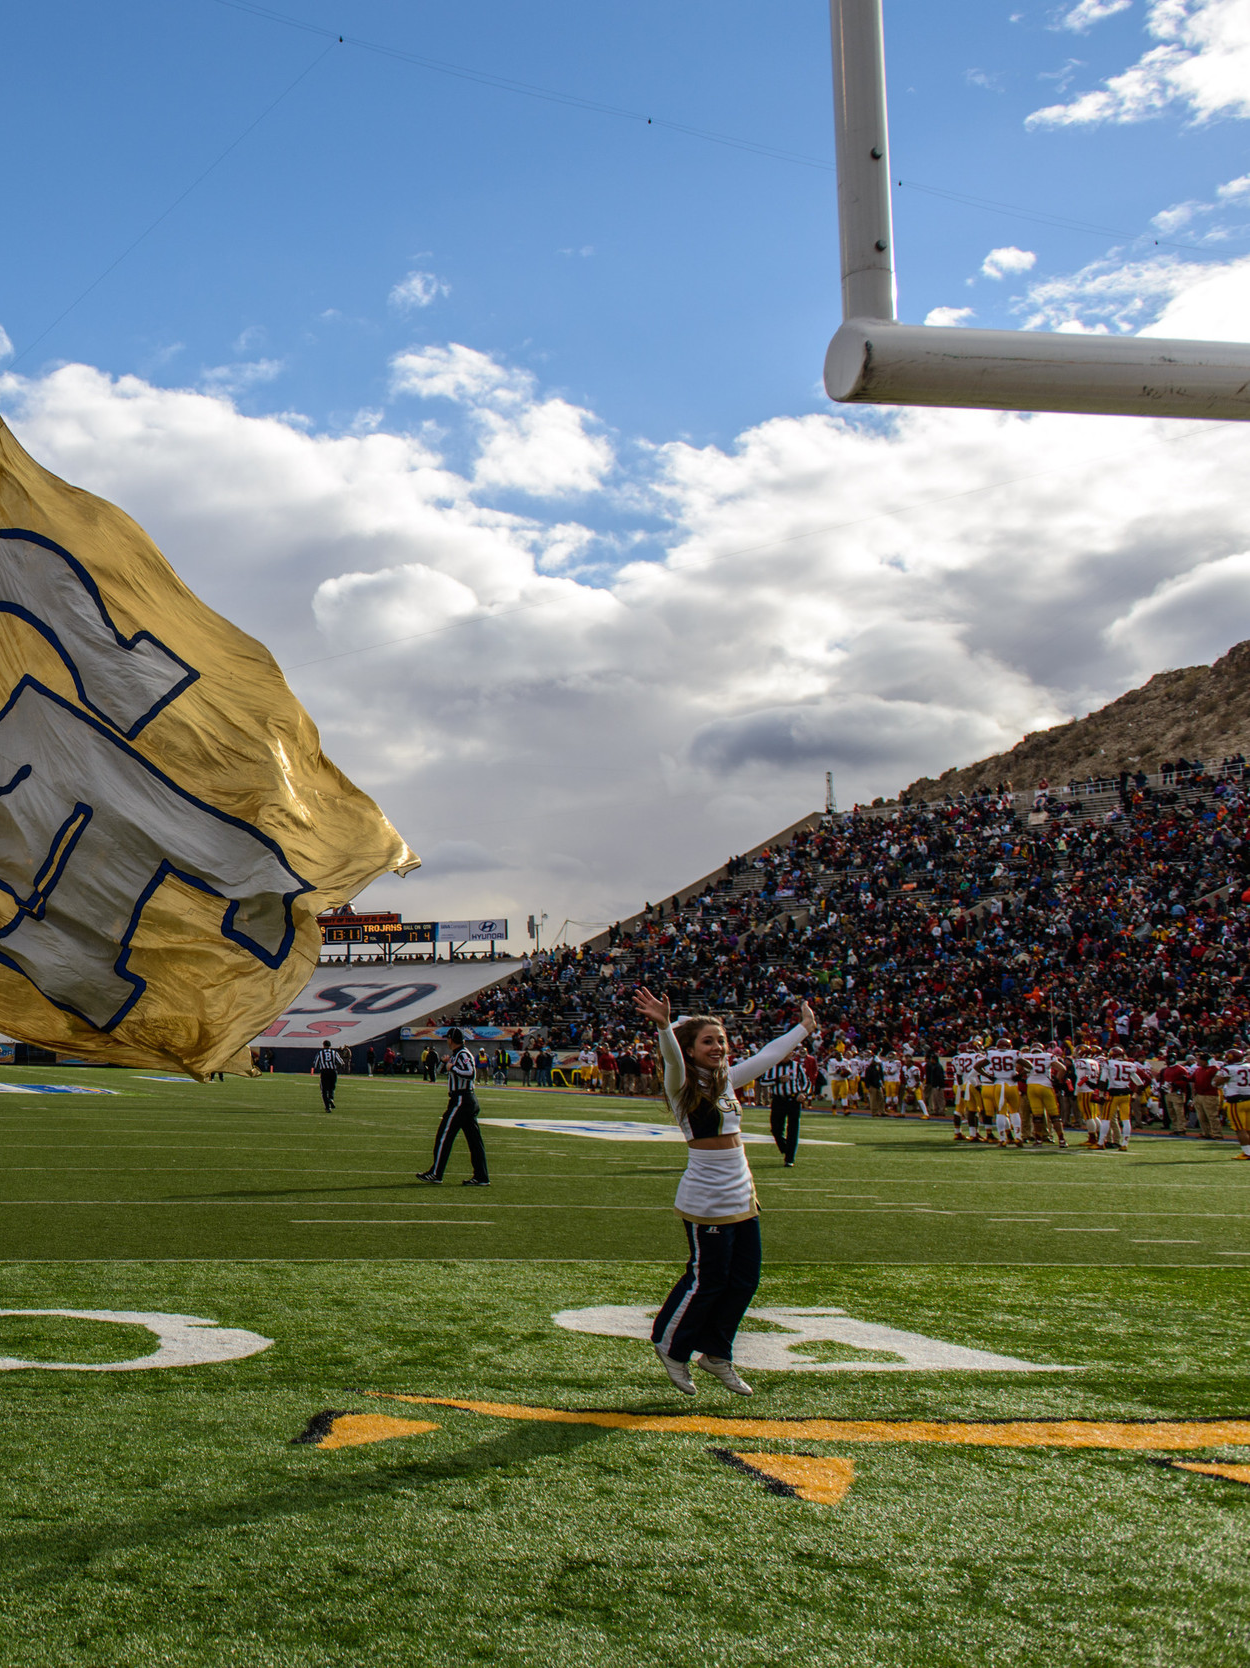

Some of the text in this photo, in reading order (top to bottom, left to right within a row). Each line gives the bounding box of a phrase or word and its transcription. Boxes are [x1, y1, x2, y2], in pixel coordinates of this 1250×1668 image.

[363, 923, 403, 932] TROJANS
[333, 929, 360, 941] 13:11
[424, 932, 430, 941] 4
[471, 932, 504, 940] HYUNDAI
[325, 1050, 332, 1062] B
[991, 1056, 1014, 1072] 86
[1114, 1064, 1131, 1082] 15
